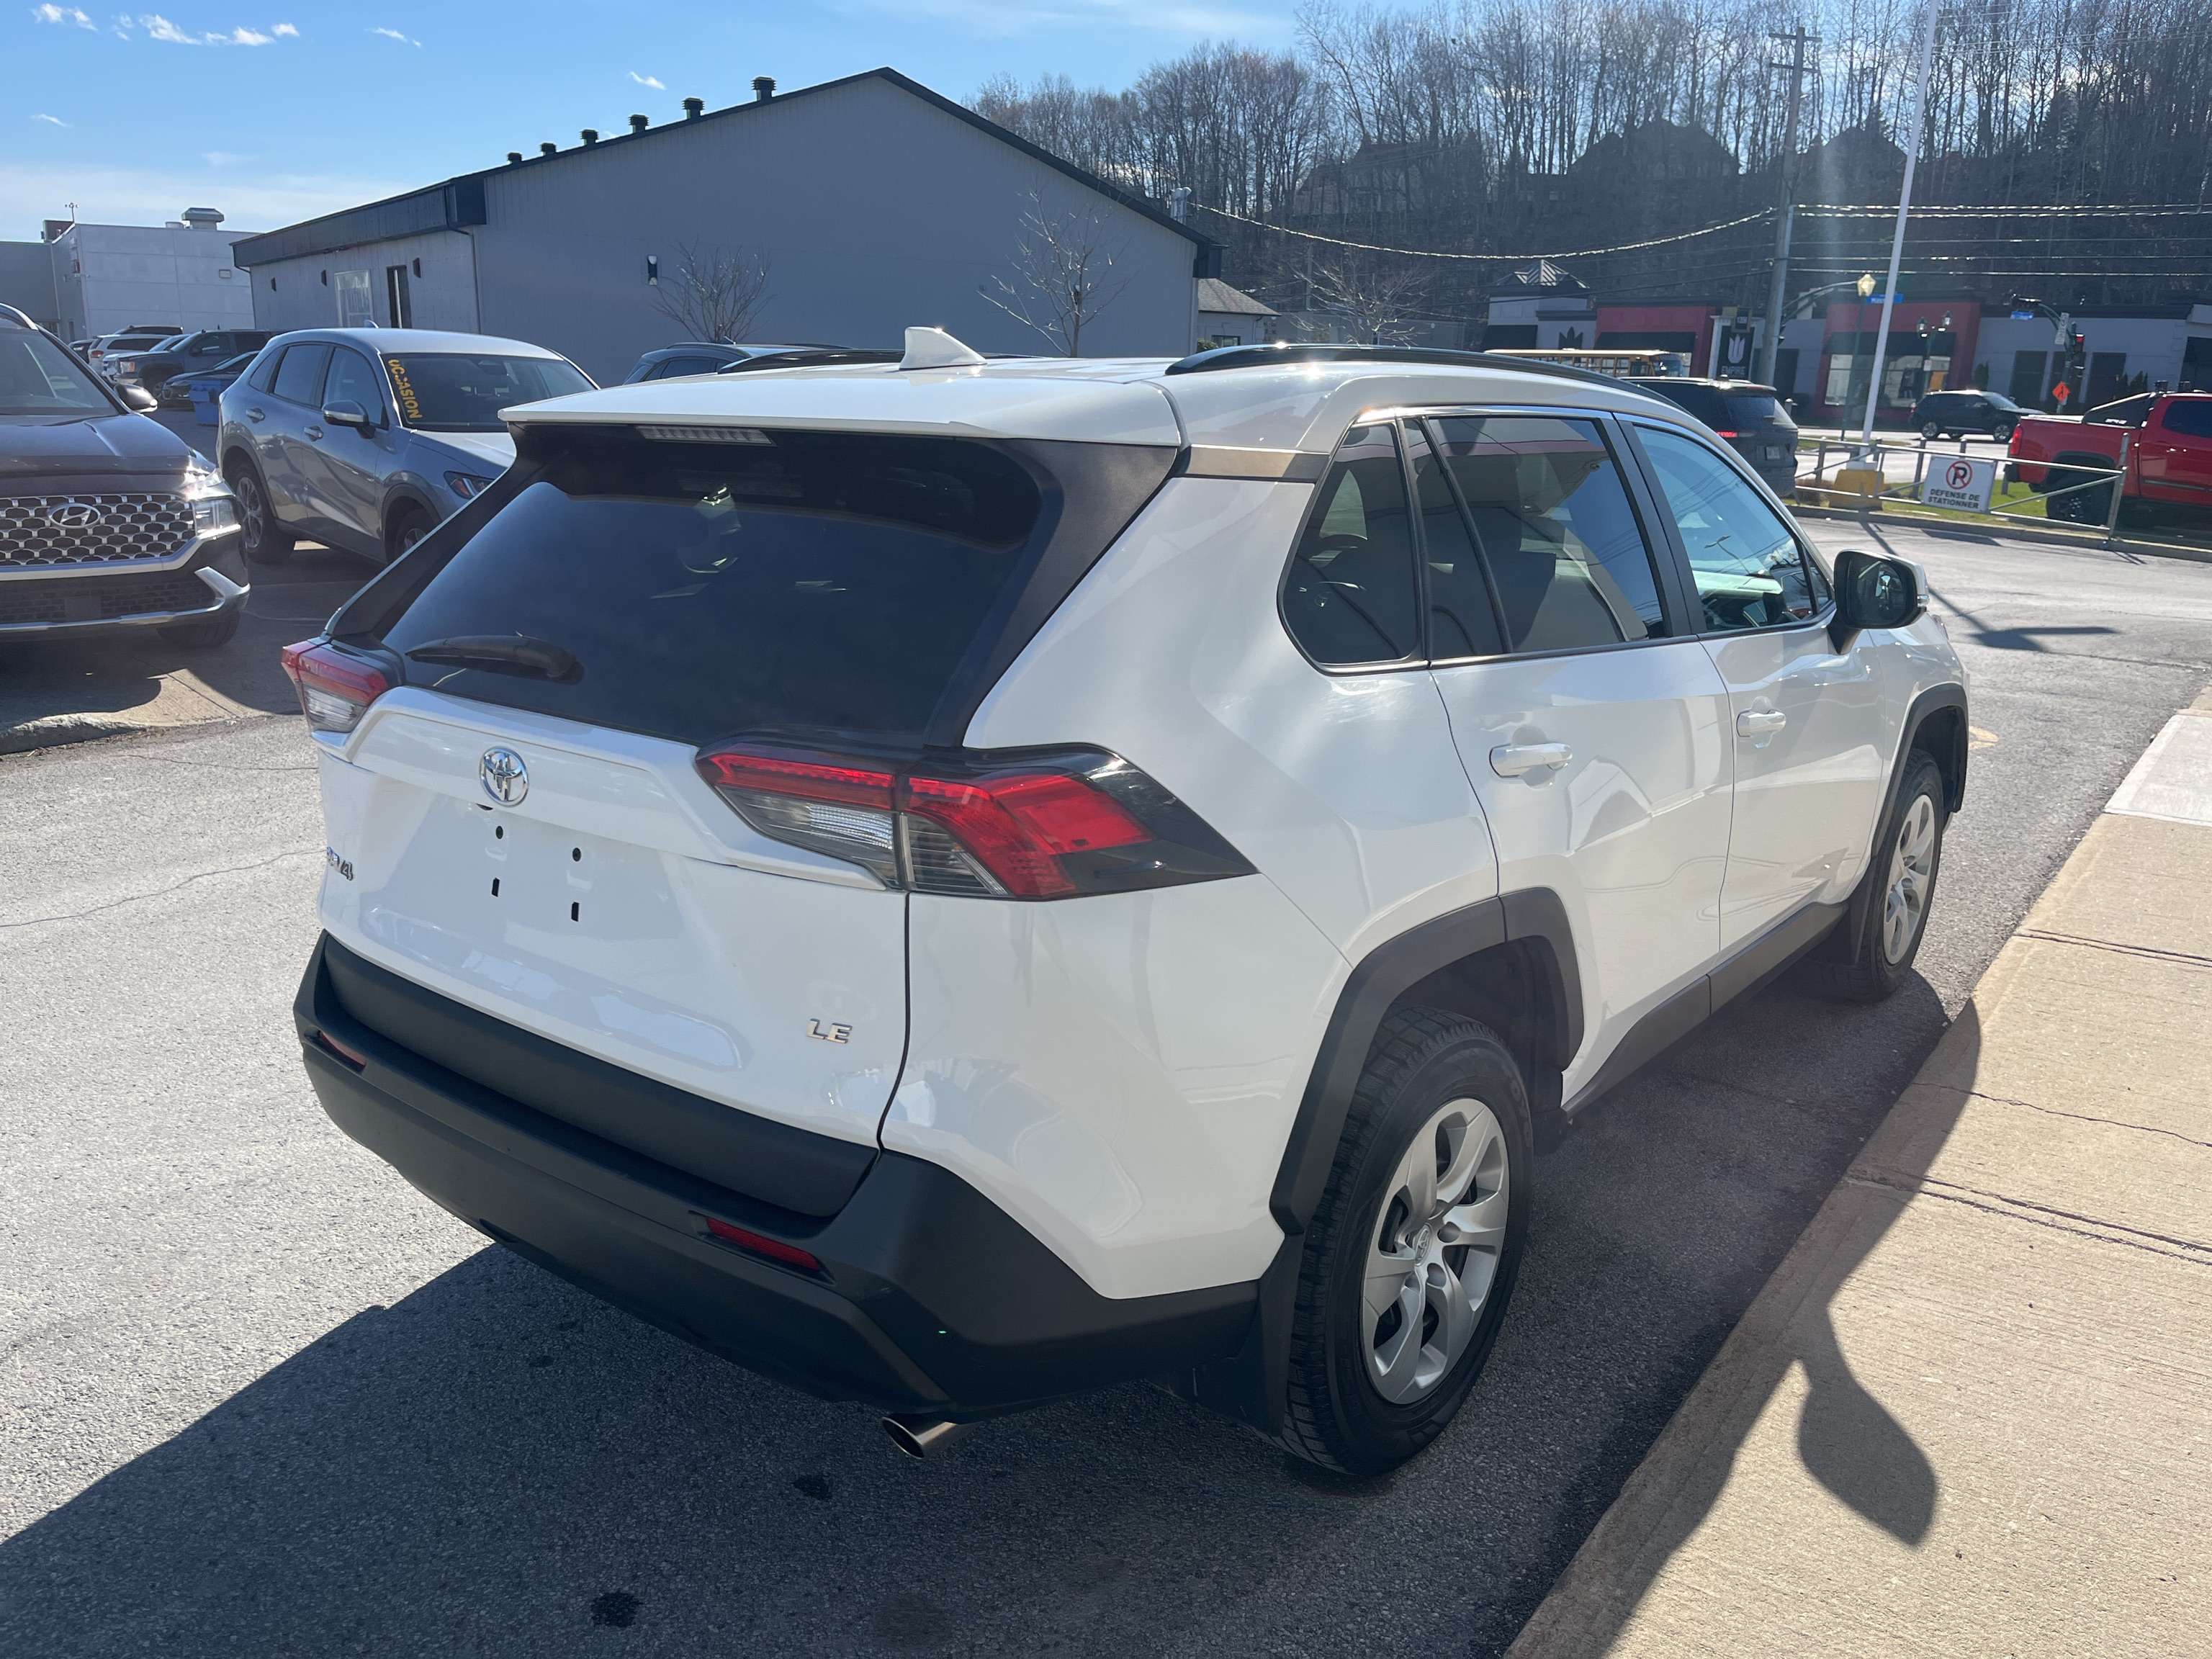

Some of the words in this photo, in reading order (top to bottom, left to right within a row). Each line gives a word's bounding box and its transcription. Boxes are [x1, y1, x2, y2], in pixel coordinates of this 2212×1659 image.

[1928, 496, 1979, 509] STATIONNER
[1969, 493, 1980, 502] DE
[806, 1018, 853, 1044] LE
